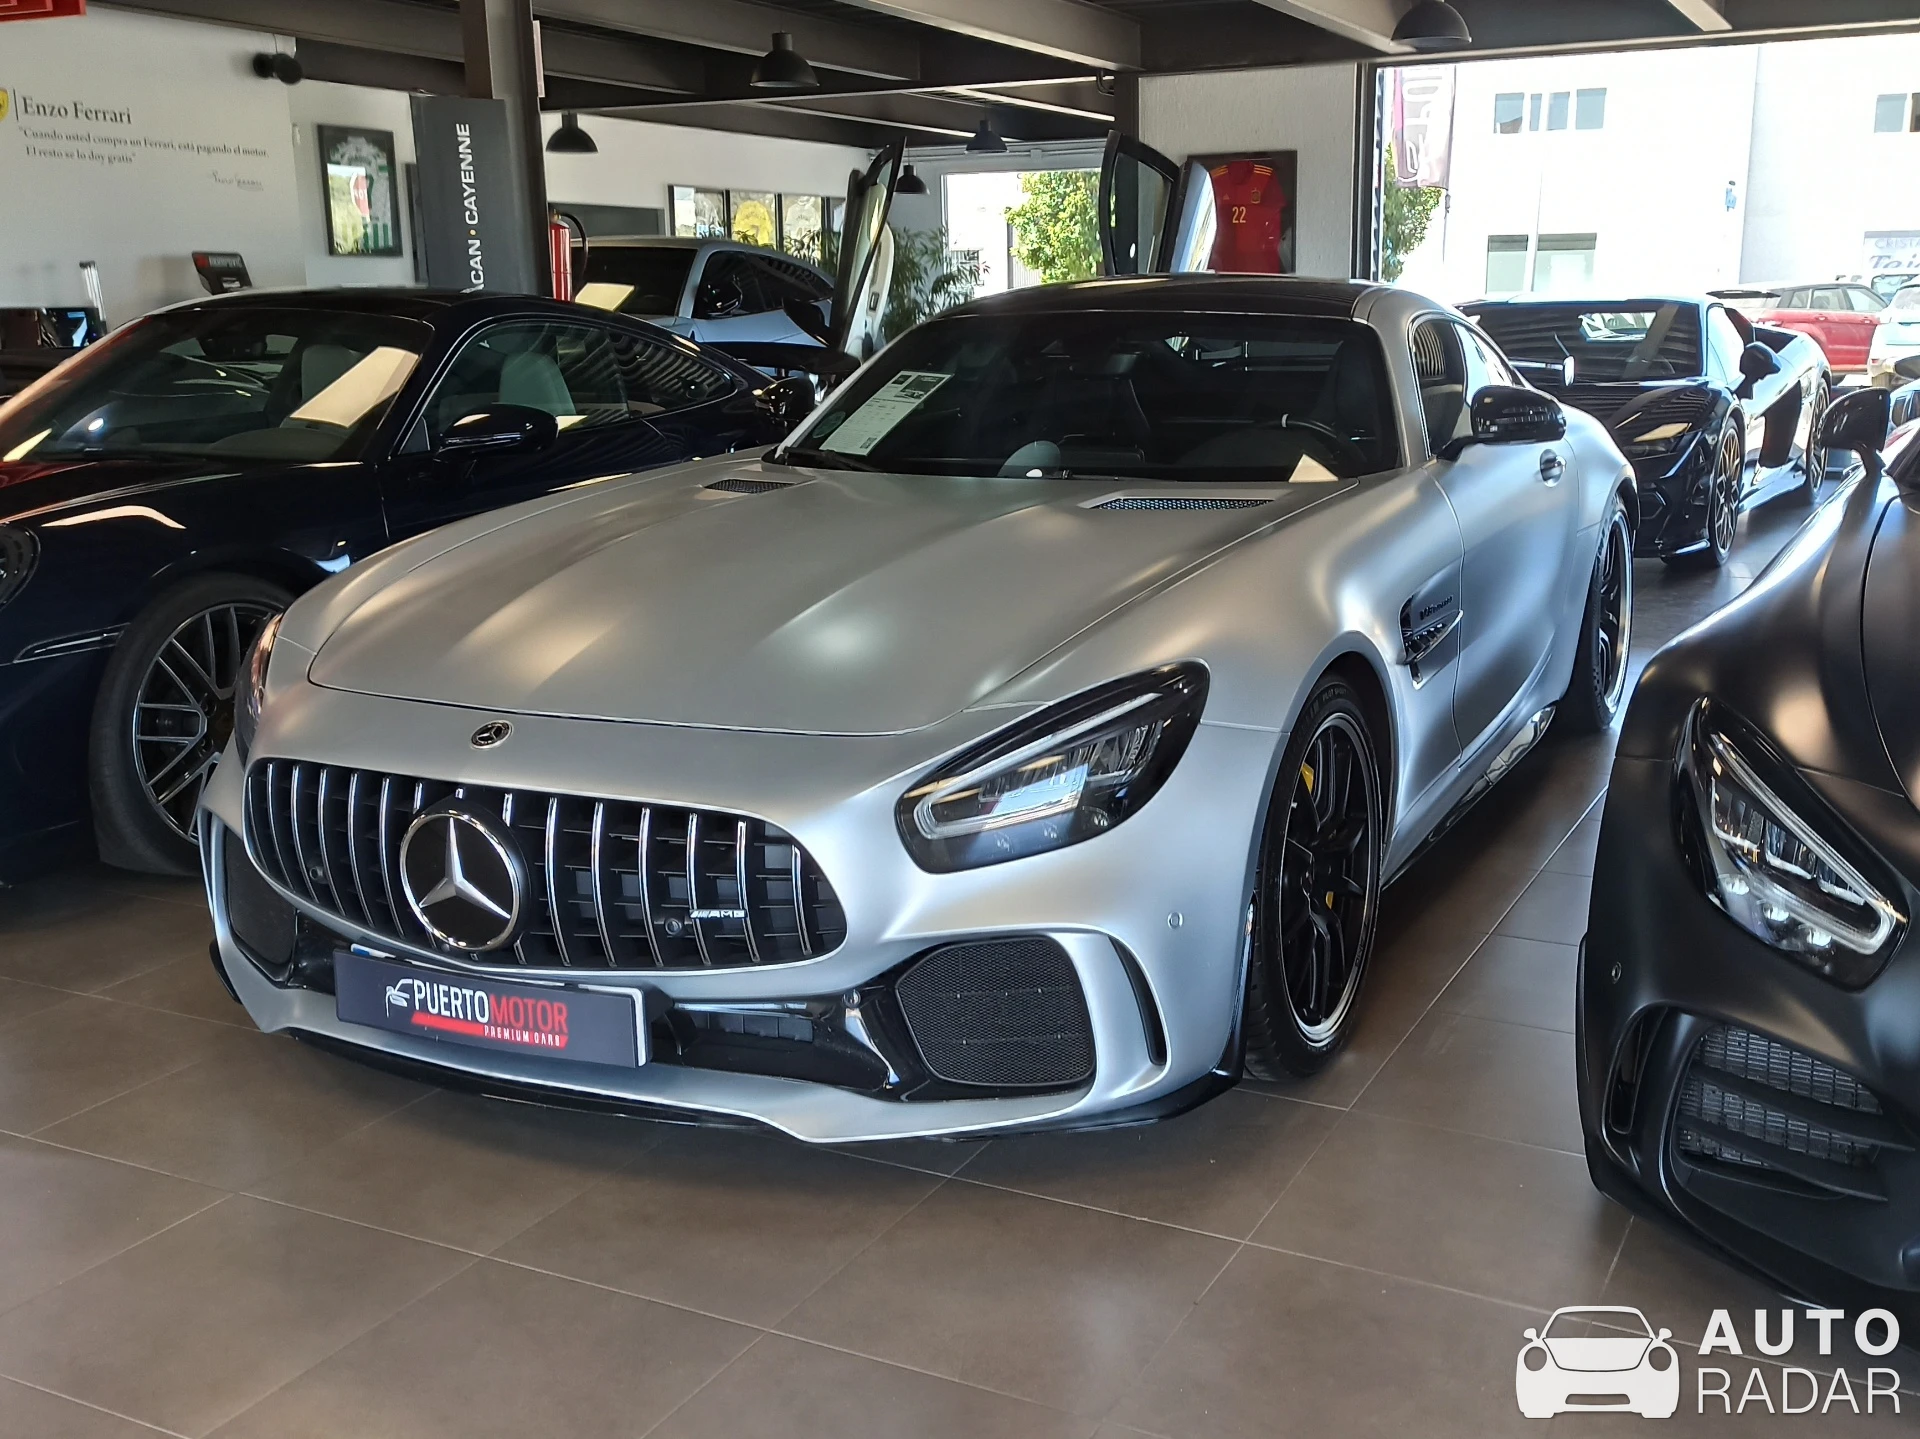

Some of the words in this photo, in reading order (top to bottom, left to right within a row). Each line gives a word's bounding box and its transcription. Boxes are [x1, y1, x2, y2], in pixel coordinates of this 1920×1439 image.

[22, 96, 69, 118] Enzo
[72, 101, 132, 124] Ferrari
[65, 132, 91, 142] usted
[93, 136, 128, 149] compra
[130, 138, 142, 146] un
[196, 143, 232, 155] pagando
[233, 145, 241, 154] el
[26, 144, 36, 155] El
[38, 148, 63, 158] resto
[76, 148, 87, 158] lo
[88, 150, 105, 164] doy
[455, 123, 479, 225] CAYENNE
[1232, 206, 1247, 224] 22
[706, 909, 745, 918] AMG
[484, 1025, 530, 1043] PREMIUM
